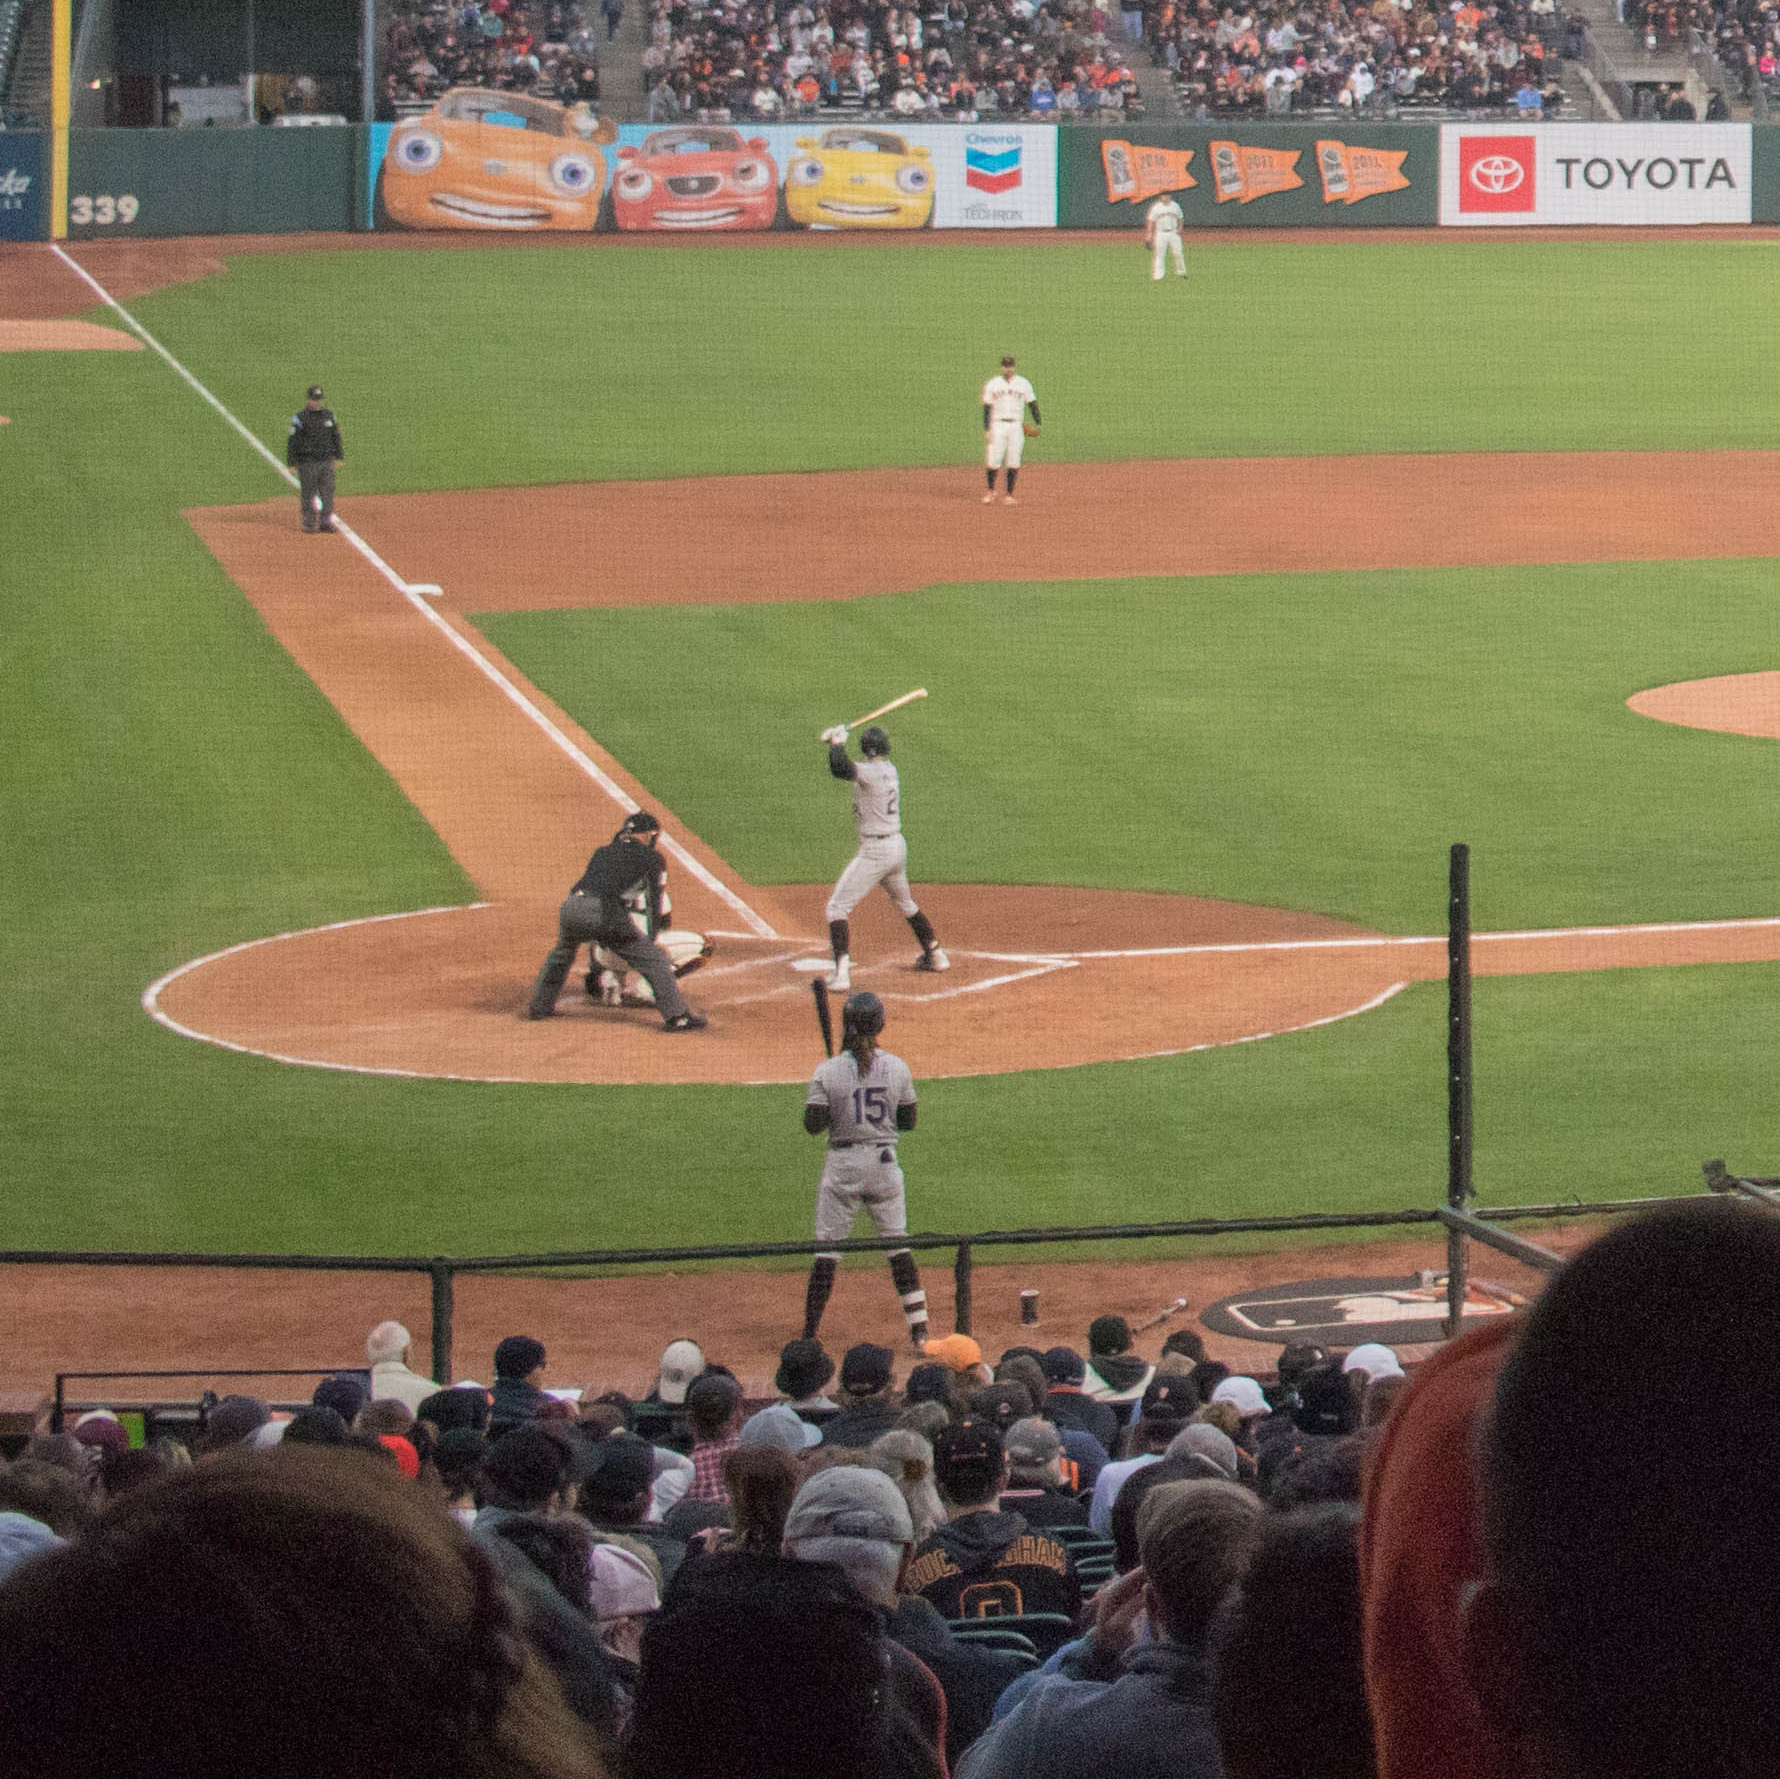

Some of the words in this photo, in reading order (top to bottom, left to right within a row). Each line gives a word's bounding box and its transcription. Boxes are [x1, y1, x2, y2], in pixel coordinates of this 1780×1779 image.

[966, 132, 1023, 146] Chevron
[1556, 157, 1737, 191] TOYOTA
[70, 195, 140, 224] 339
[853, 1086, 889, 1125] 15
